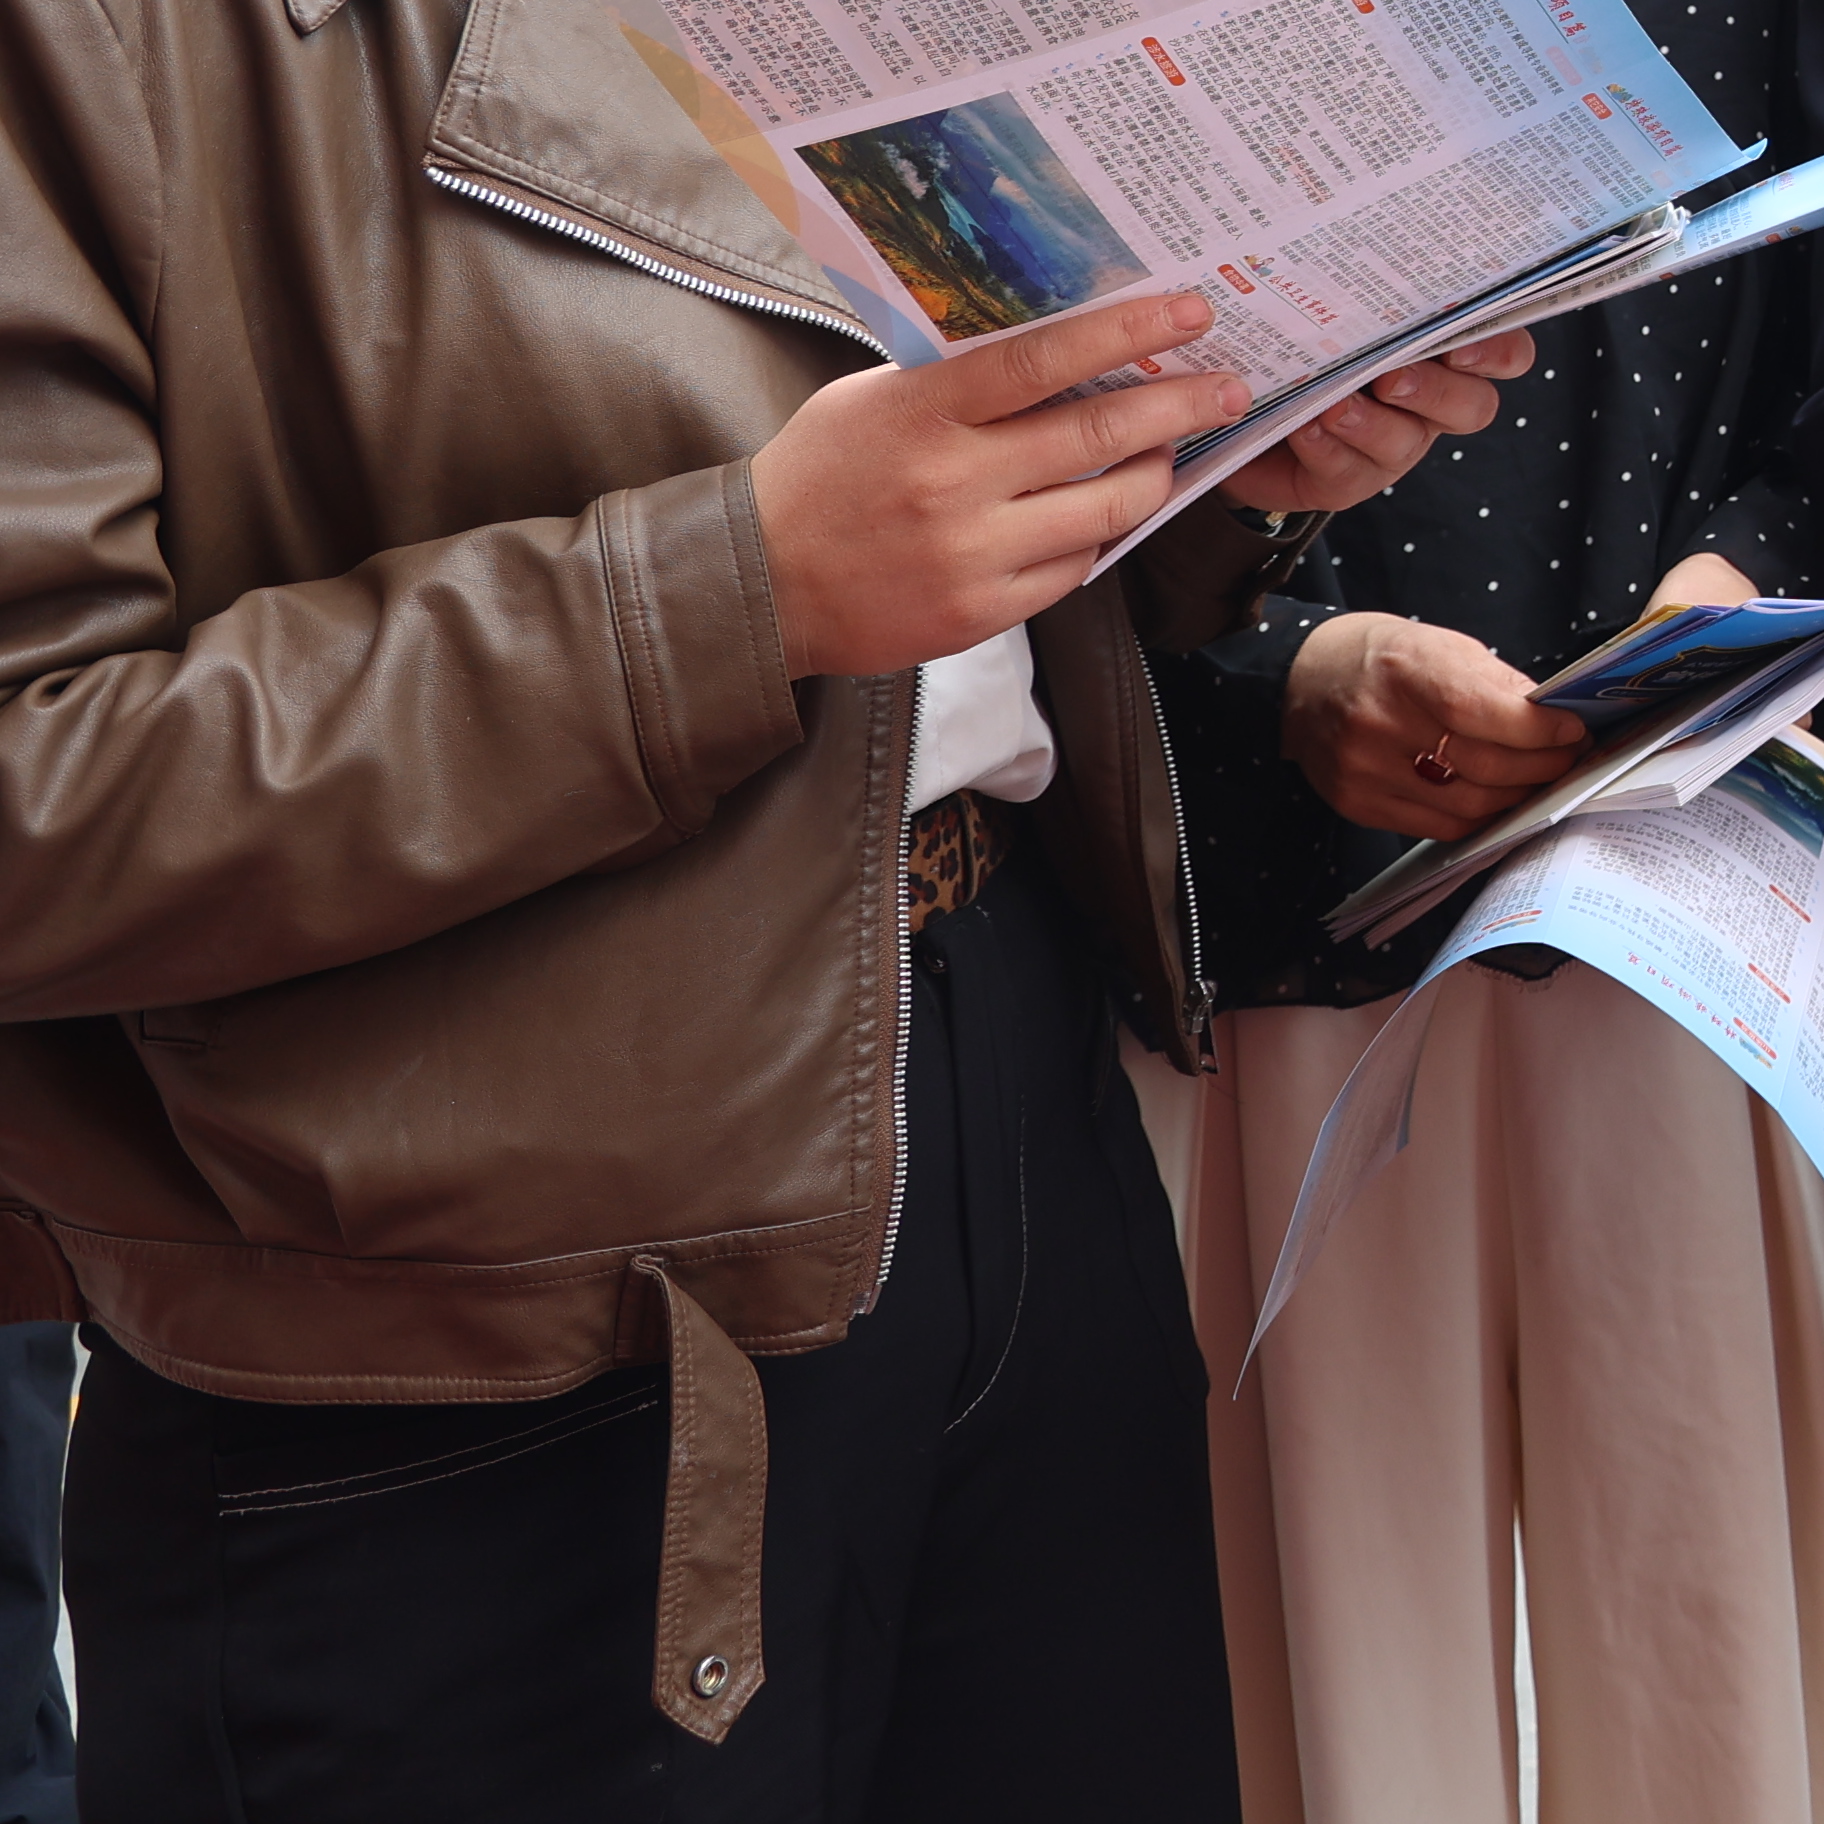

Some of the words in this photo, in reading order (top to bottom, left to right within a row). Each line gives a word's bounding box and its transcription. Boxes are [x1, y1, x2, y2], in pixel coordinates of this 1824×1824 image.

[1621, 96, 1685, 157] 特殊旅游项目篇
[1264, 271, 1340, 326] 公共卫生事件篇
[1625, 950, 1738, 1042] 特殊旅游项目篇
